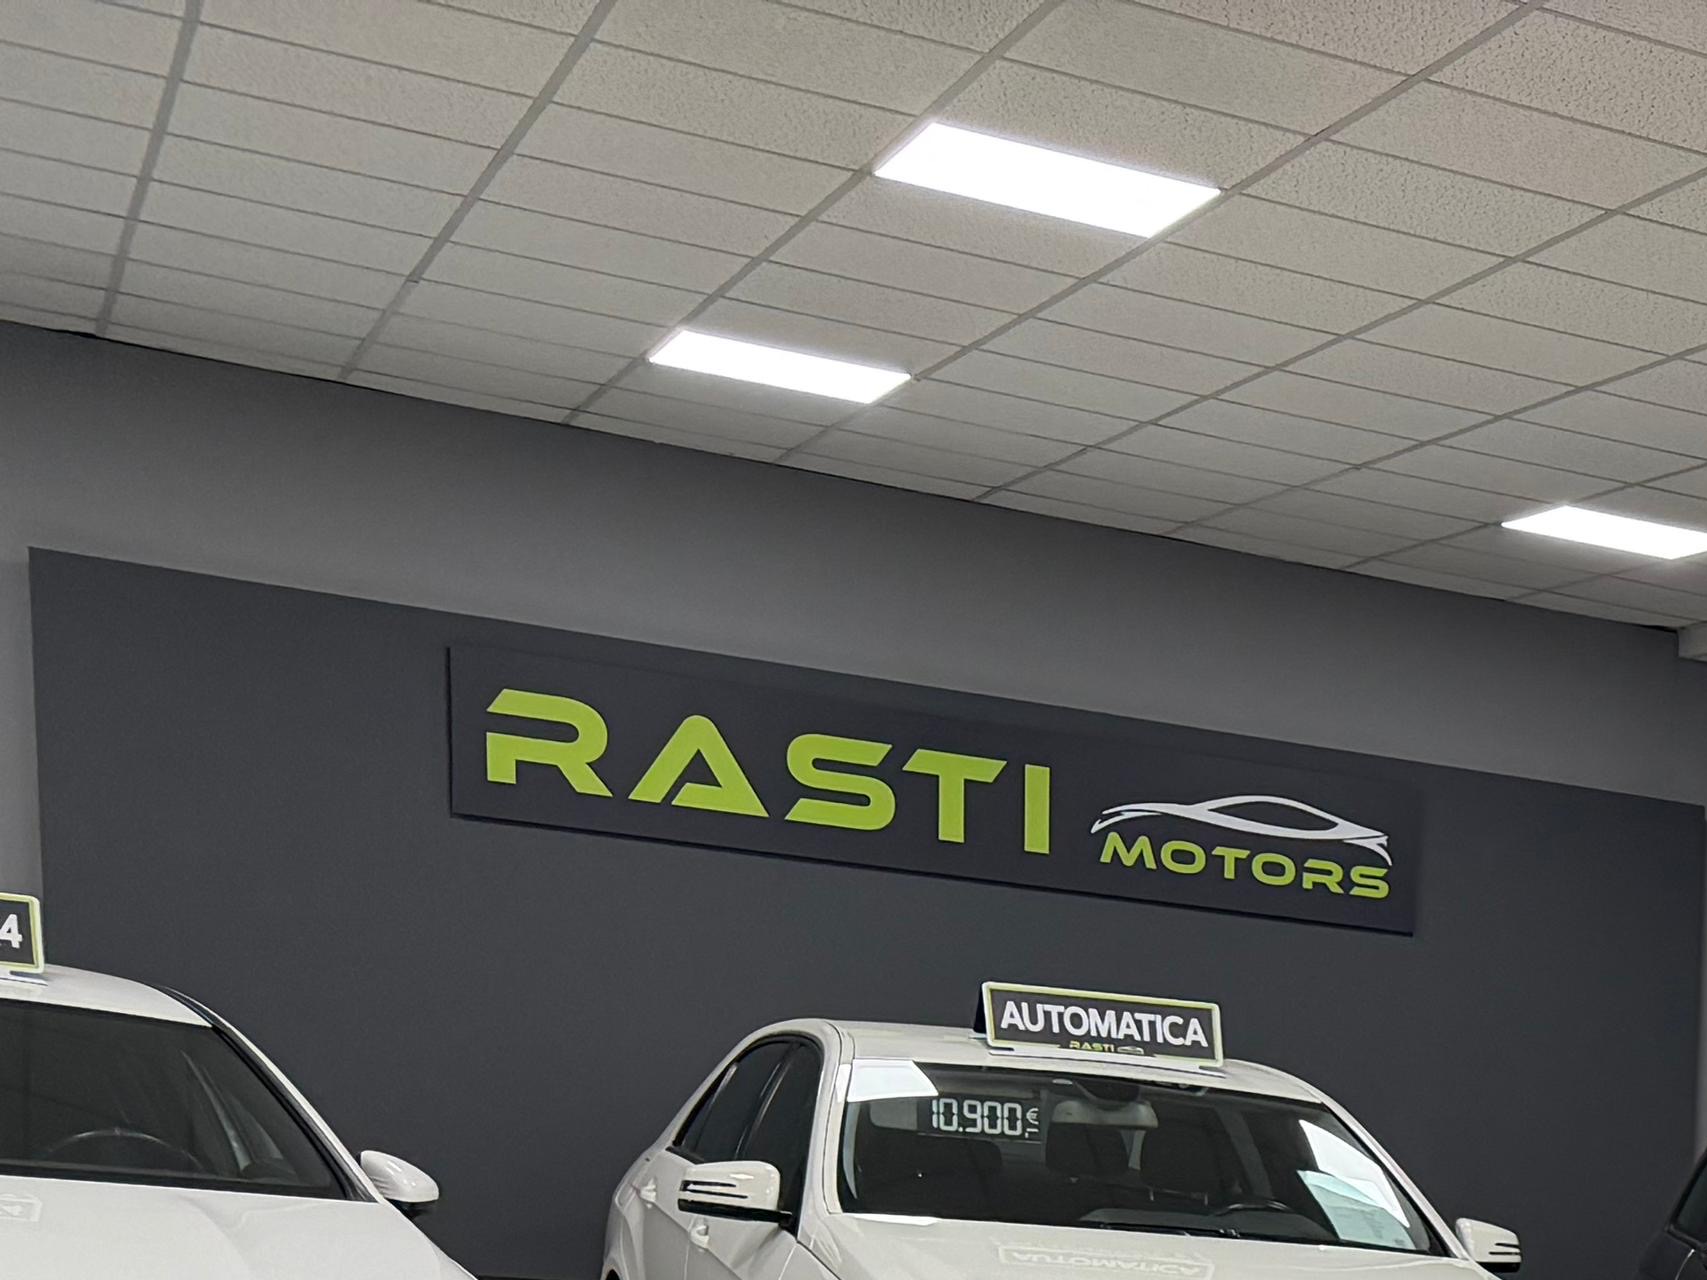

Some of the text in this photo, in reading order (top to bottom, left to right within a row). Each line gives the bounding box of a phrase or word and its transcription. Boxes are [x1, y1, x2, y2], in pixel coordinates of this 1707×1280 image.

[486, 687, 1391, 899] RASTI MOTORS
[1001, 1000, 1209, 1047] AUTOMATICA
